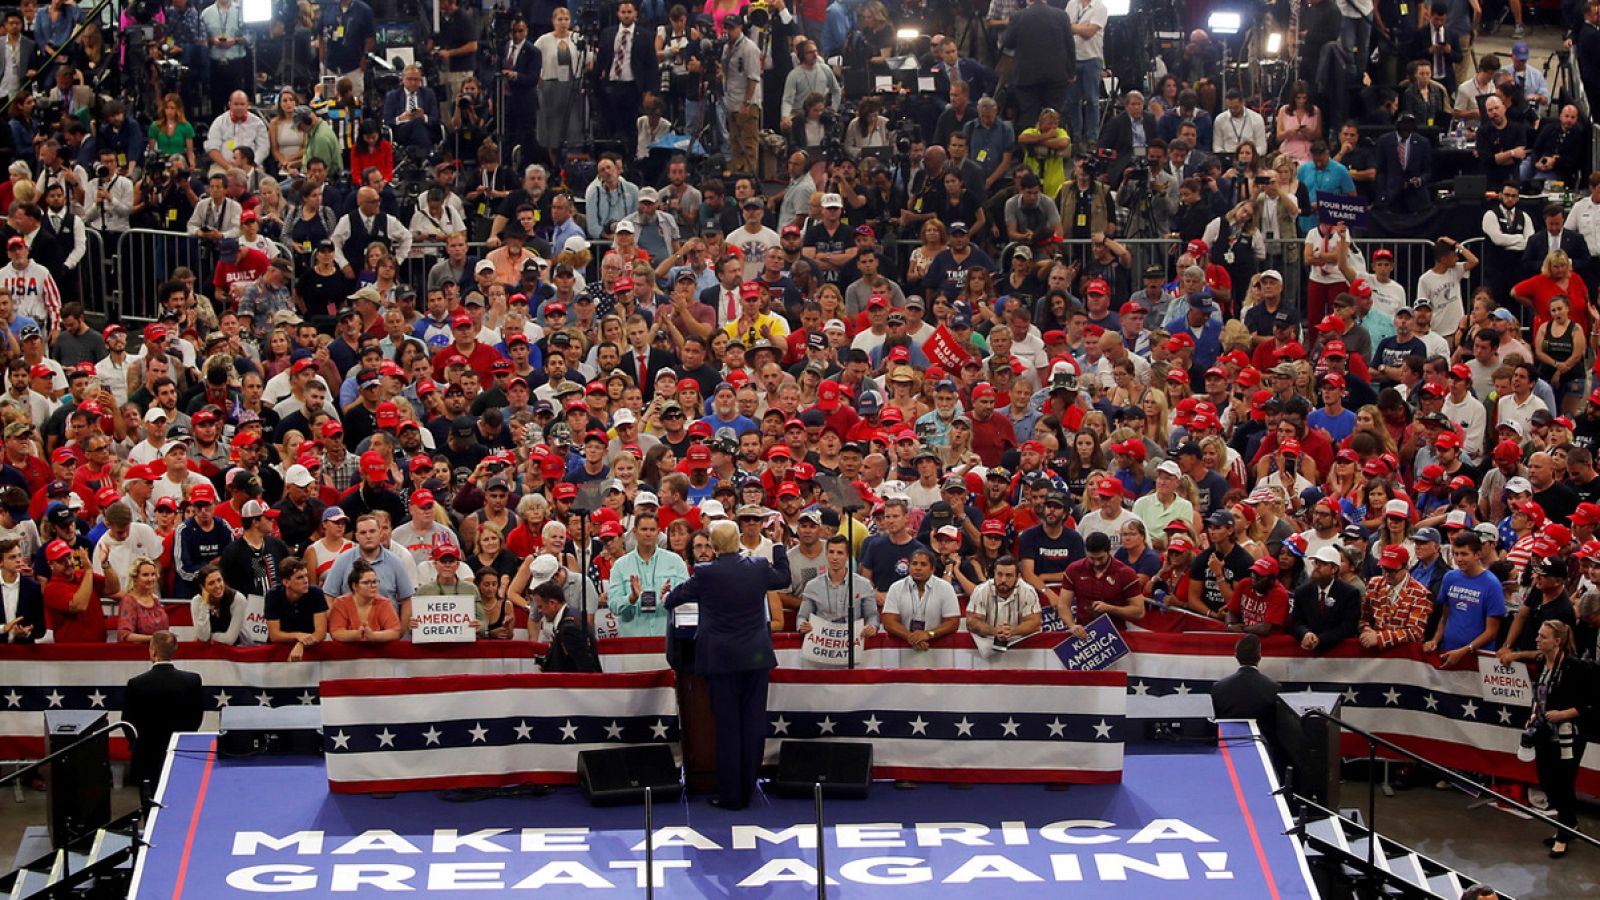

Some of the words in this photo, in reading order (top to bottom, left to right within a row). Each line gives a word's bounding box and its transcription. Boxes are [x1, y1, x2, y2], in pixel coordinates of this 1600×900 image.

[1319, 201, 1340, 210] FOUR
[1341, 204, 1364, 214] MORE
[226, 269, 256, 283] BUILT
[946, 269, 968, 279] TRU
[4, 277, 38, 296] USA
[427, 603, 457, 612] KEEP
[416, 613, 471, 625] AMERICA
[423, 626, 463, 636] GREAT!
[1067, 632, 1118, 669] AMERICA
[1081, 646, 1117, 671] GREAT!
[1484, 674, 1529, 689] AMERICA
[1491, 686, 1524, 698] GREAT!
[232, 827, 593, 856] MAKE
[631, 819, 1220, 852] AMERICA
[226, 858, 691, 892] GREAT
[736, 851, 1235, 888] AGAIN!
